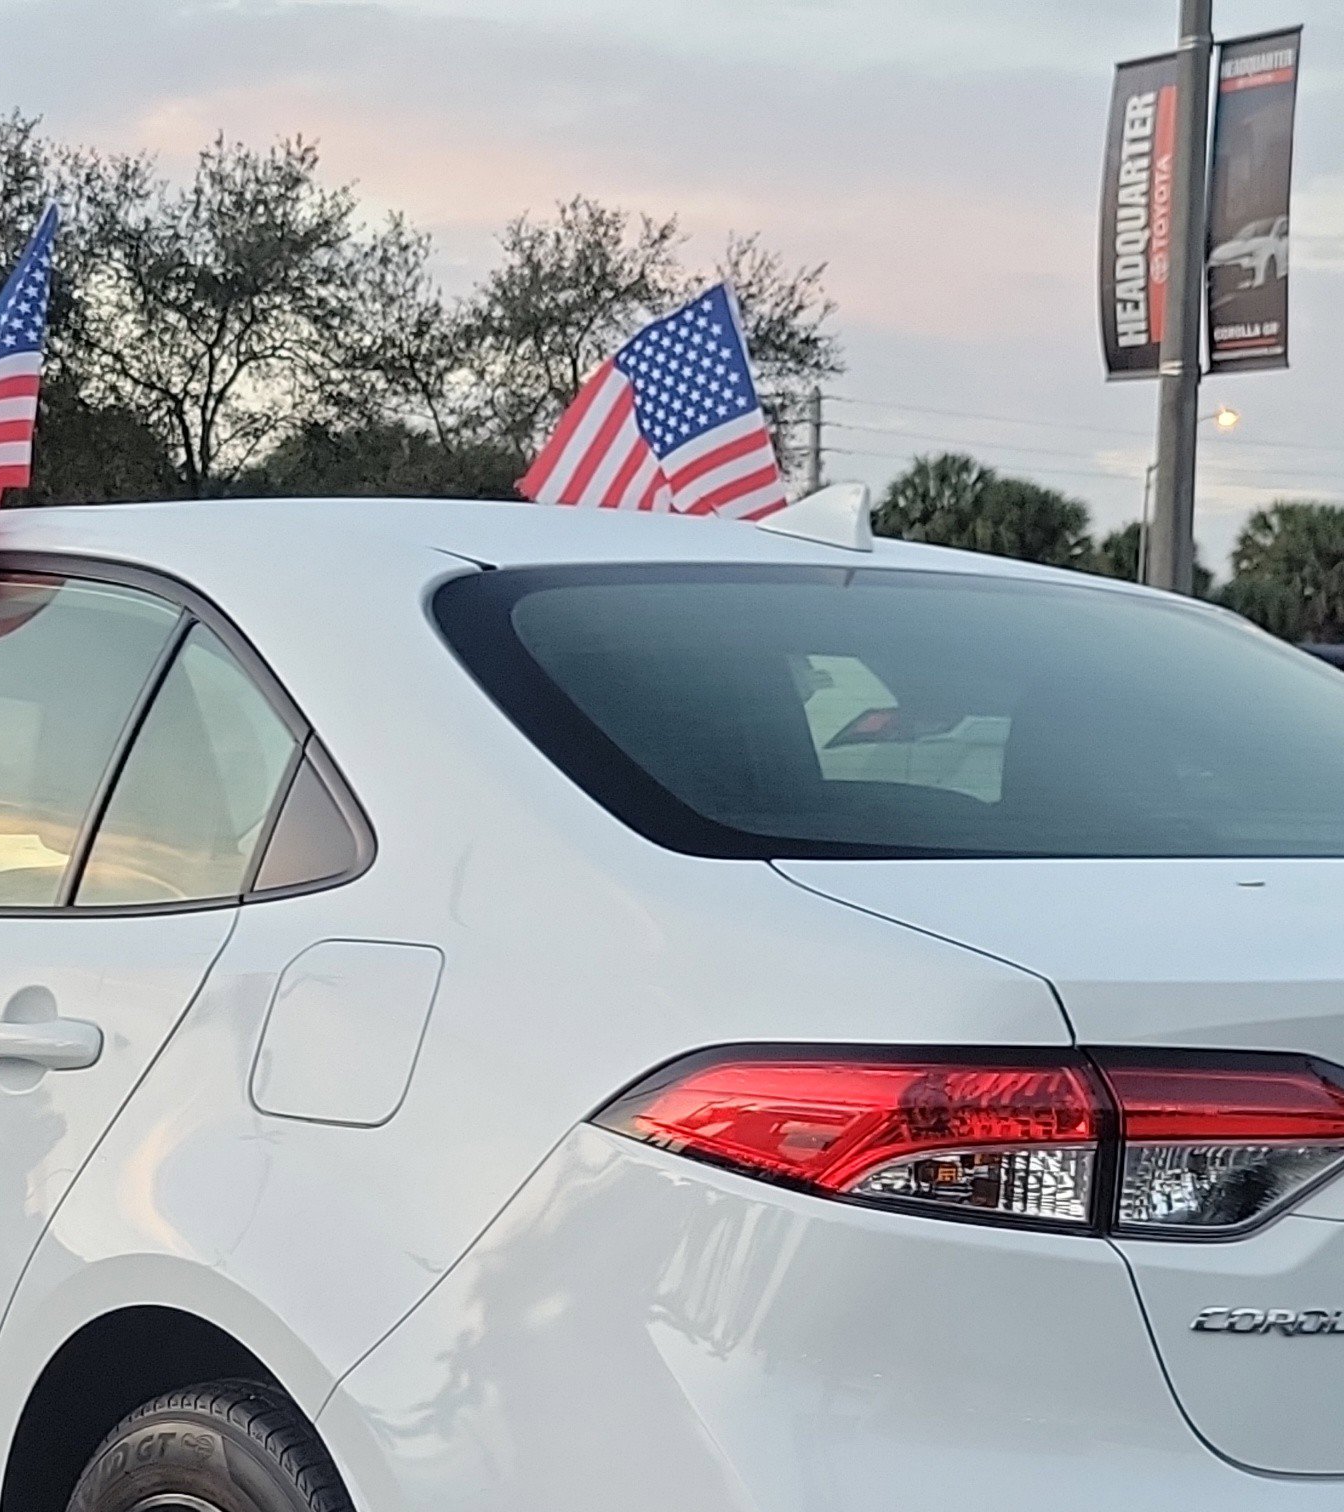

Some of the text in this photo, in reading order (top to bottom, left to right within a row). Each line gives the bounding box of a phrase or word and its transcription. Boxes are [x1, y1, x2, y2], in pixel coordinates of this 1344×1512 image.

[1115, 91, 1158, 348] HEADQUARTER
[1151, 153, 1172, 253] TOYOTA
[136, 1432, 177, 1463] GT
